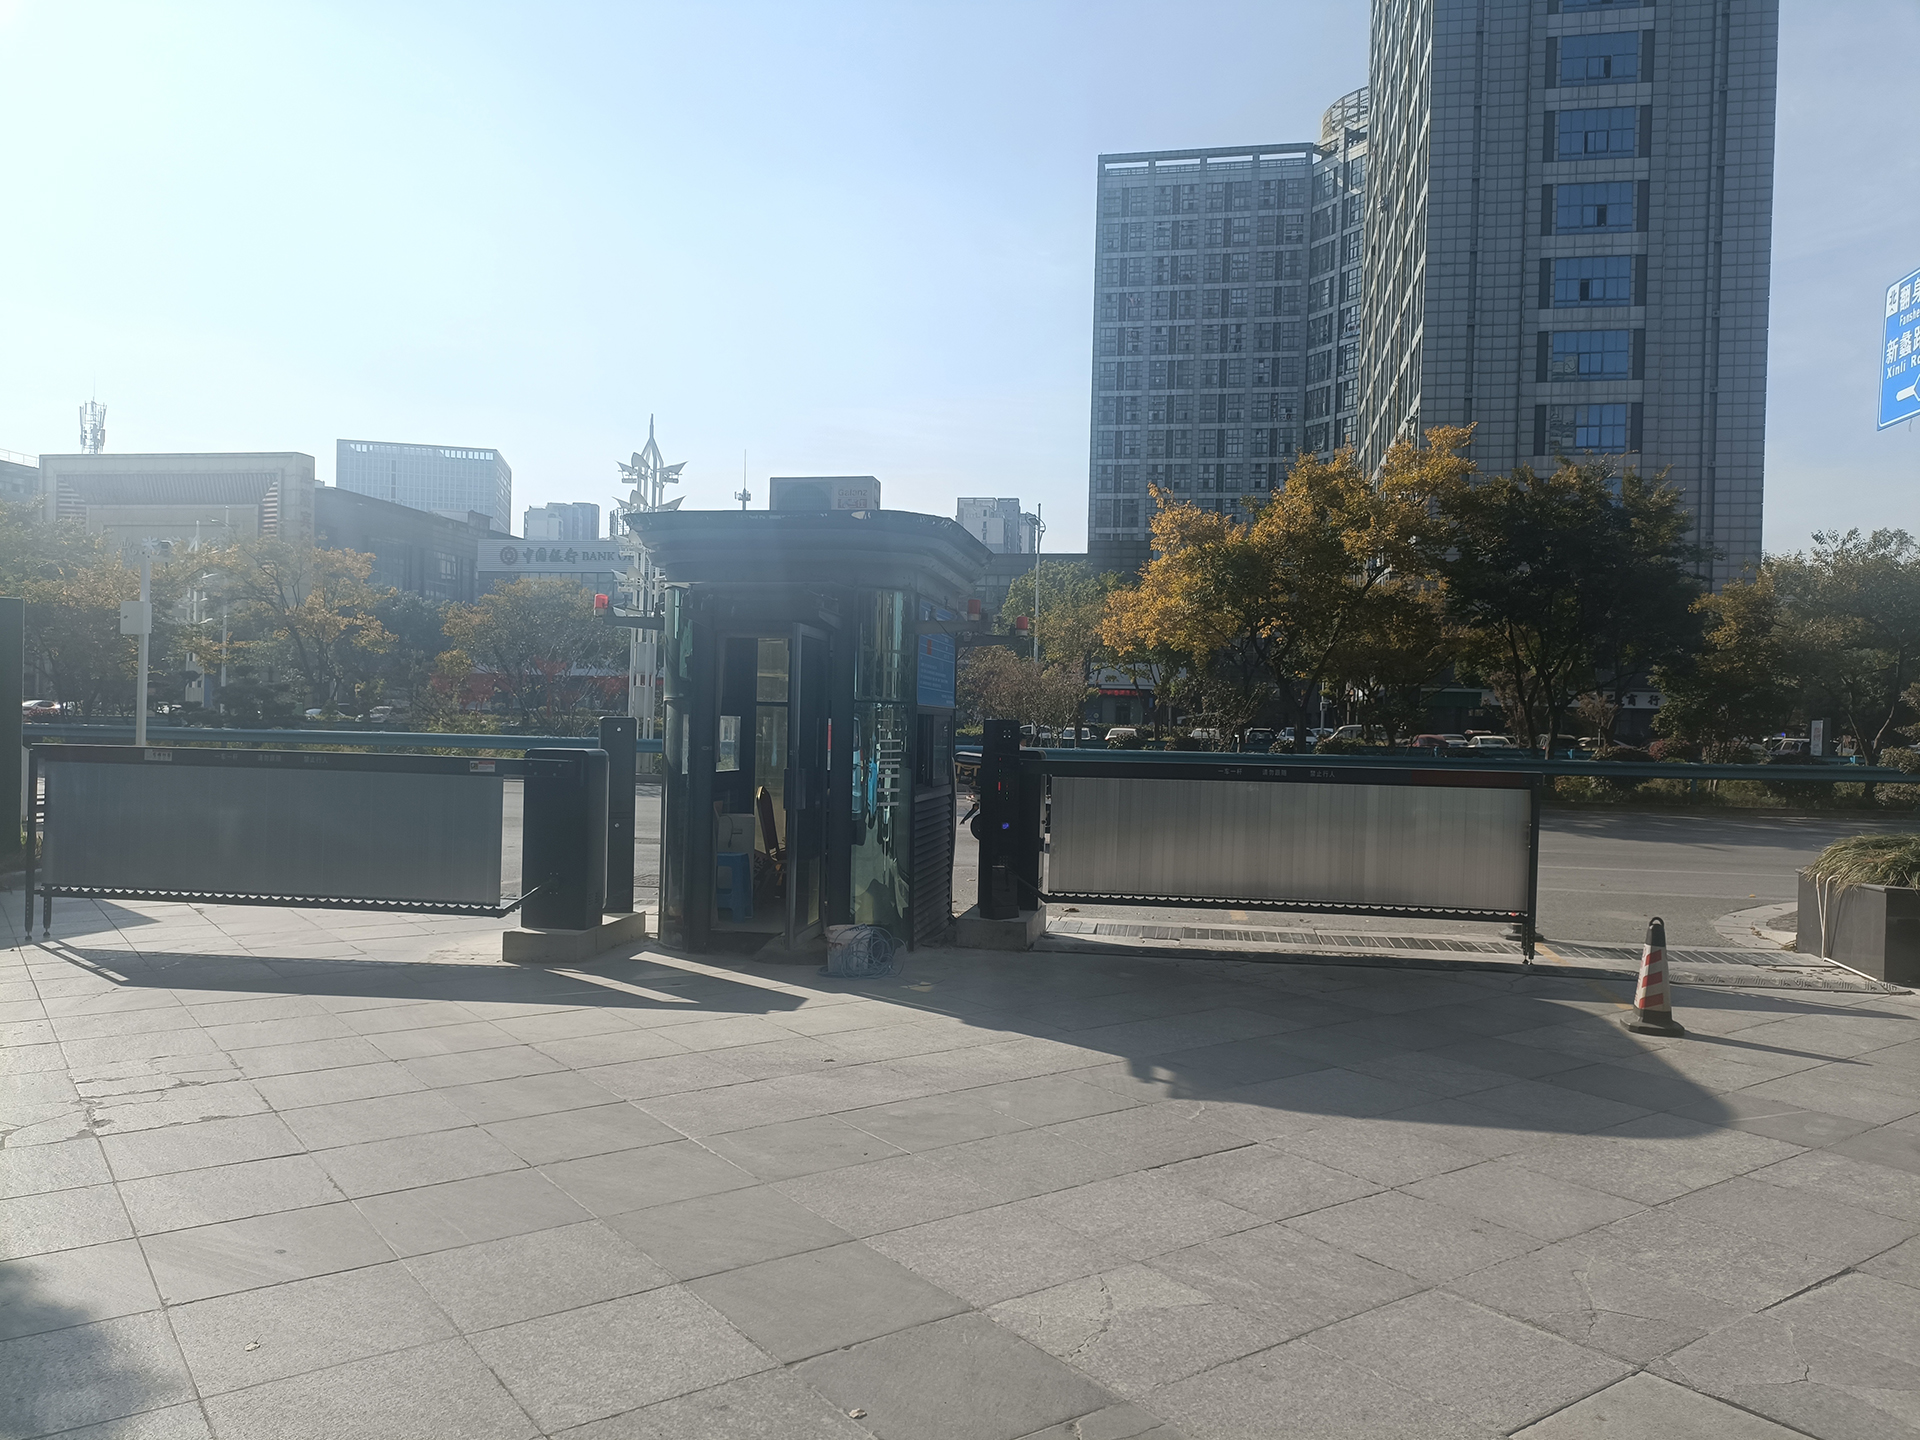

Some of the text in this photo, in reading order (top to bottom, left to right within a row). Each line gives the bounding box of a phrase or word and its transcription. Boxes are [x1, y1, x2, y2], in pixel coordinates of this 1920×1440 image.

[1889, 289, 1898, 306] 北
[1886, 359, 1906, 380] Xinli
[838, 489, 868, 497] Galanz
[522, 547, 579, 564] 中国银行
[582, 551, 615, 561] BANK
[303, 755, 328, 764] 禁止行人
[1217, 768, 1242, 776] 一车一杆
[1310, 770, 1336, 778] 禁止行人
